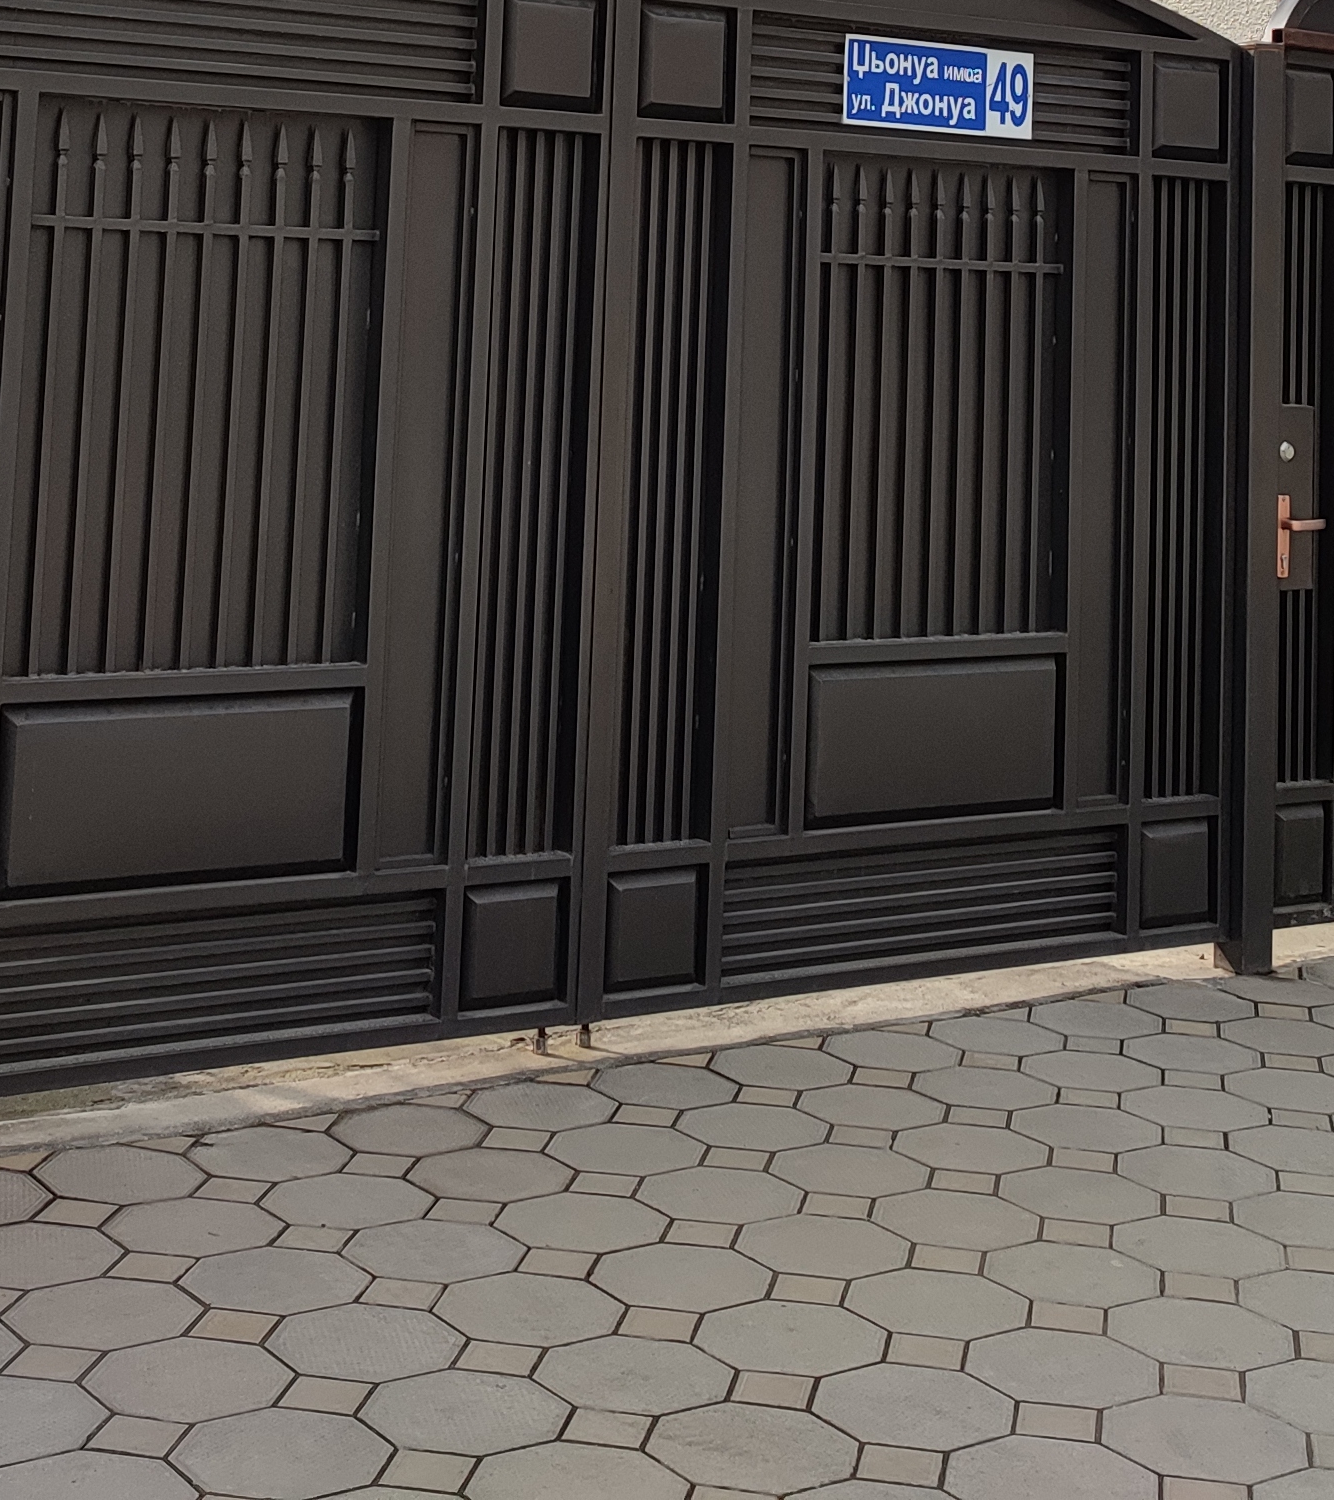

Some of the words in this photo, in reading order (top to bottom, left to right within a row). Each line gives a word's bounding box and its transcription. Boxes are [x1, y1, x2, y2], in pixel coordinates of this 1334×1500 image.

[851, 93, 875, 114] ул.
[881, 82, 976, 126] Джонуа
[989, 62, 1029, 127] 49
